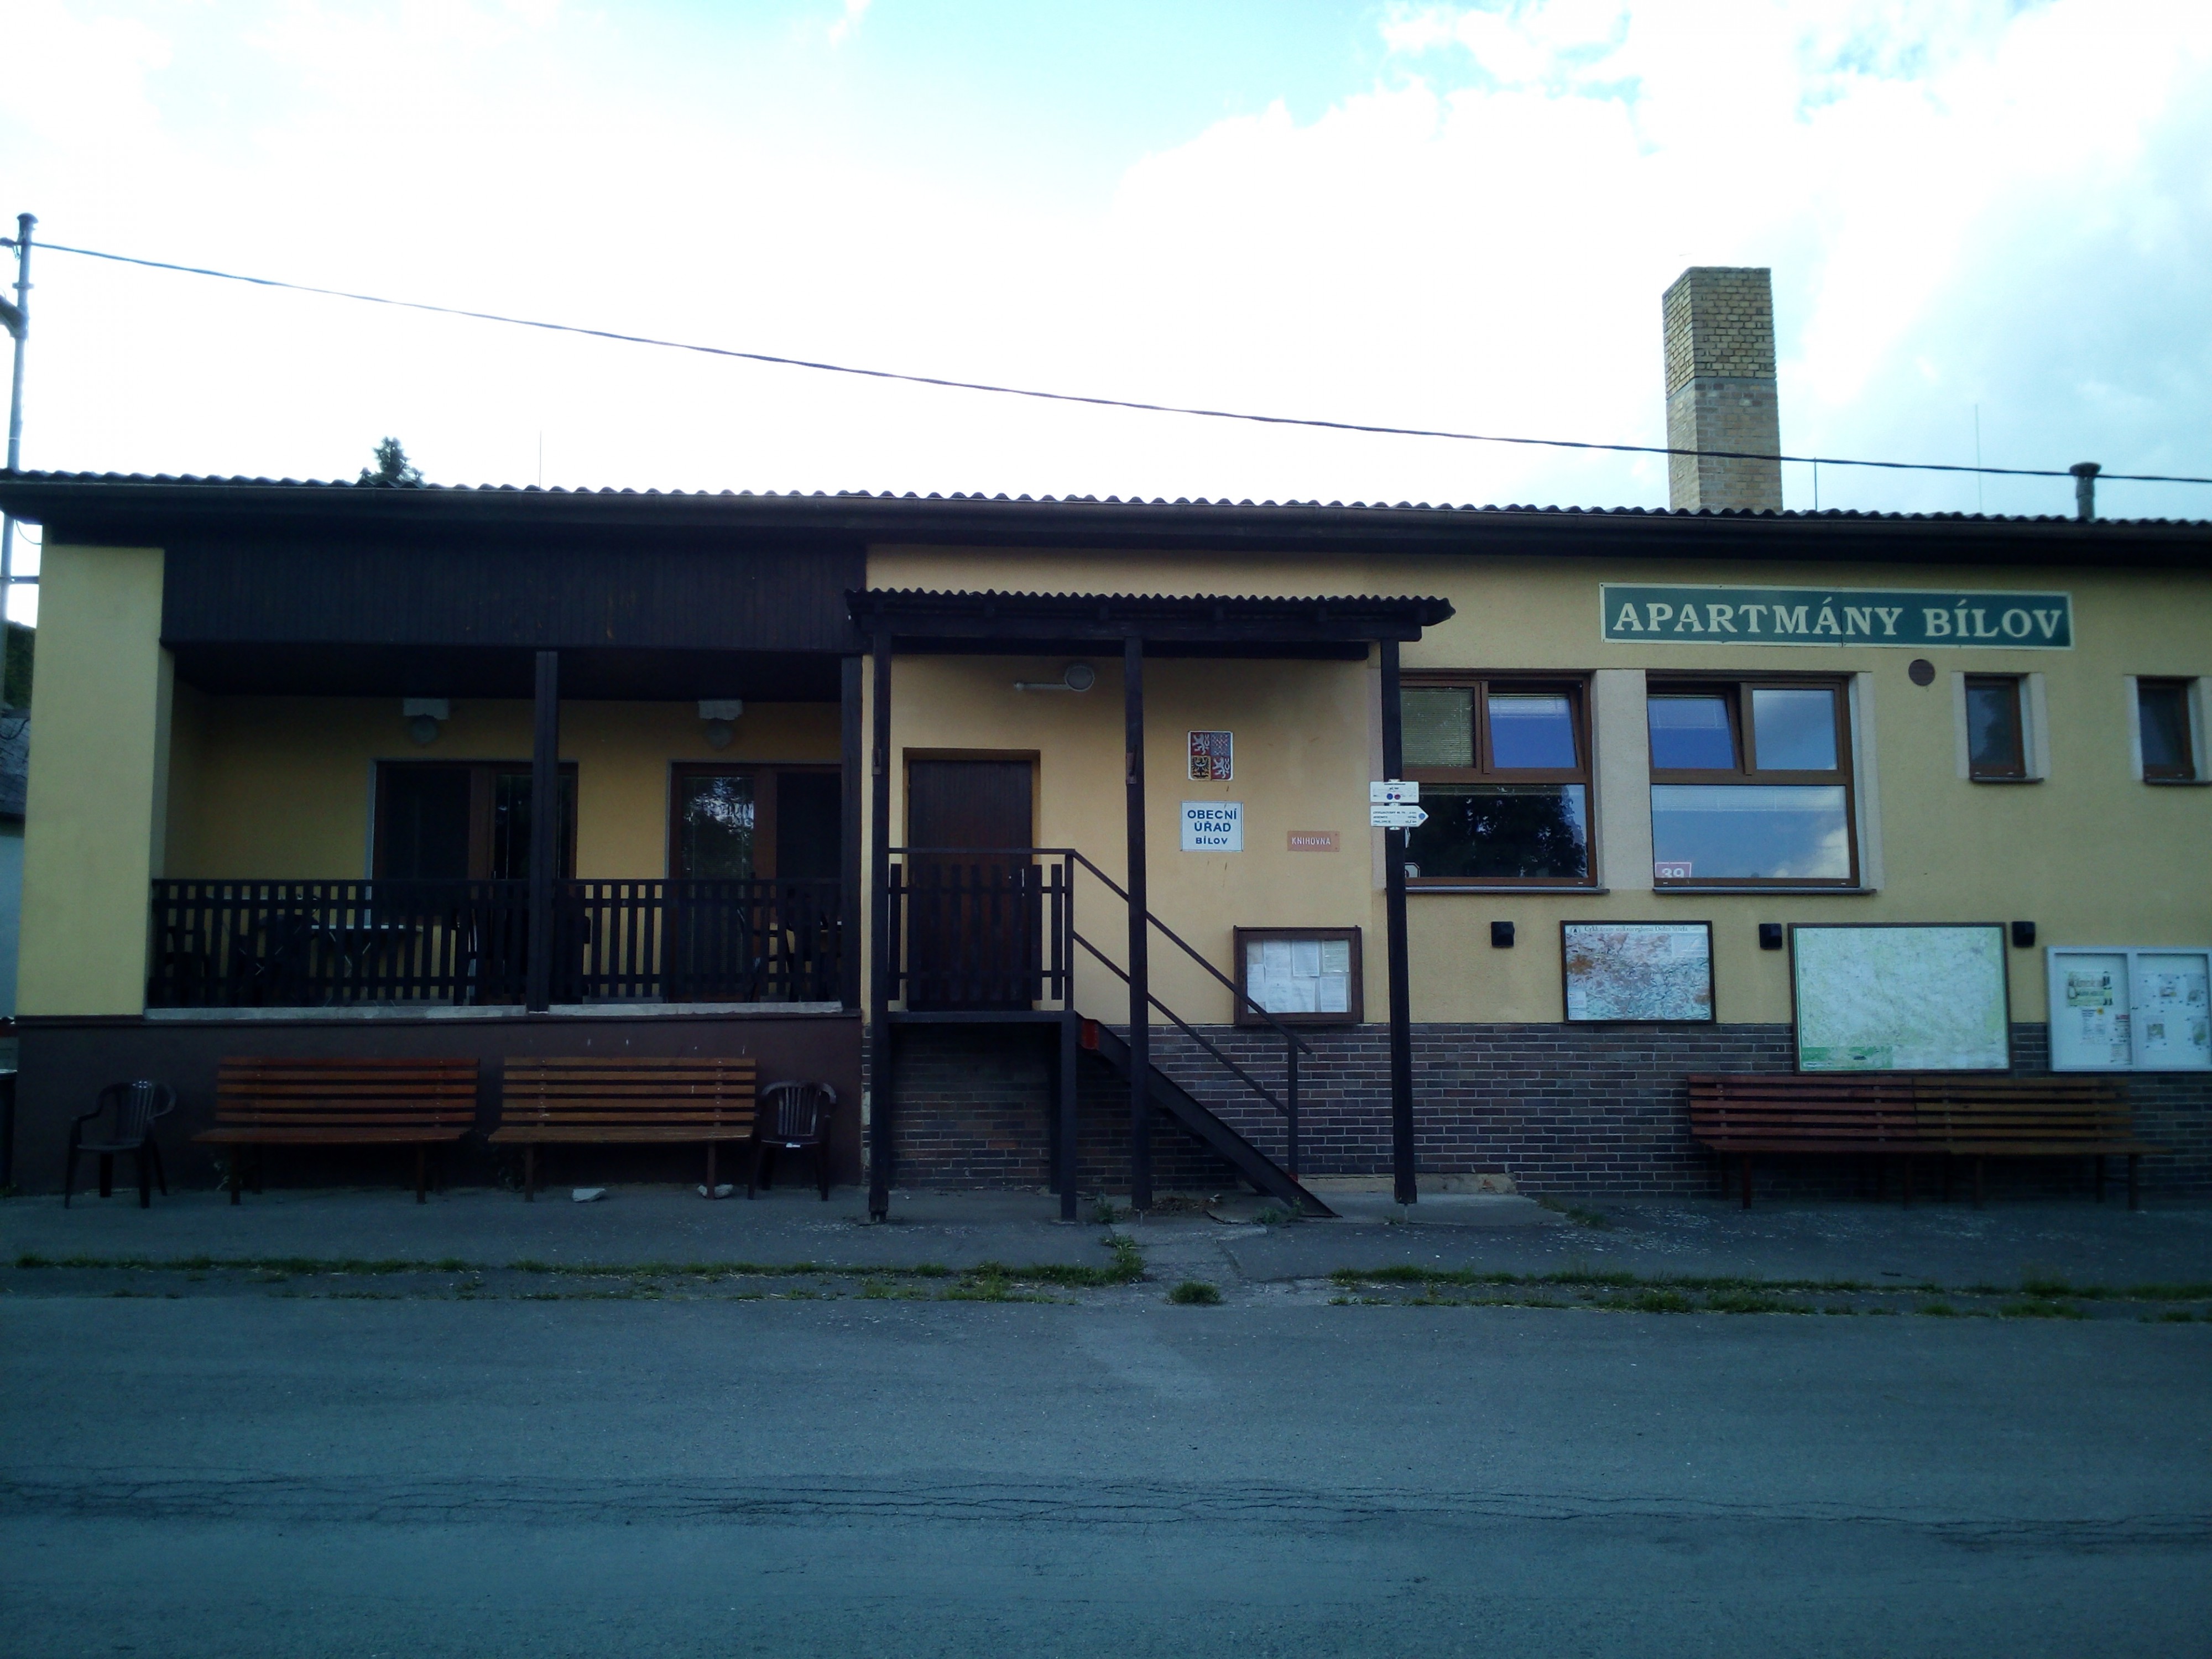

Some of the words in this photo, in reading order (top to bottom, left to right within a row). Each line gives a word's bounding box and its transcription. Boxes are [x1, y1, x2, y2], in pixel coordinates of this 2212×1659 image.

[1613, 597, 1903, 637] APARTMÁNY
[1924, 598, 2063, 639] BÍLOV
[1187, 808, 1237, 820] OBECNÍ
[1194, 821, 1231, 832] ÚŘAD
[1196, 836, 1228, 844] BÍLOV
[1291, 837, 1331, 845] KNIHOVNA
